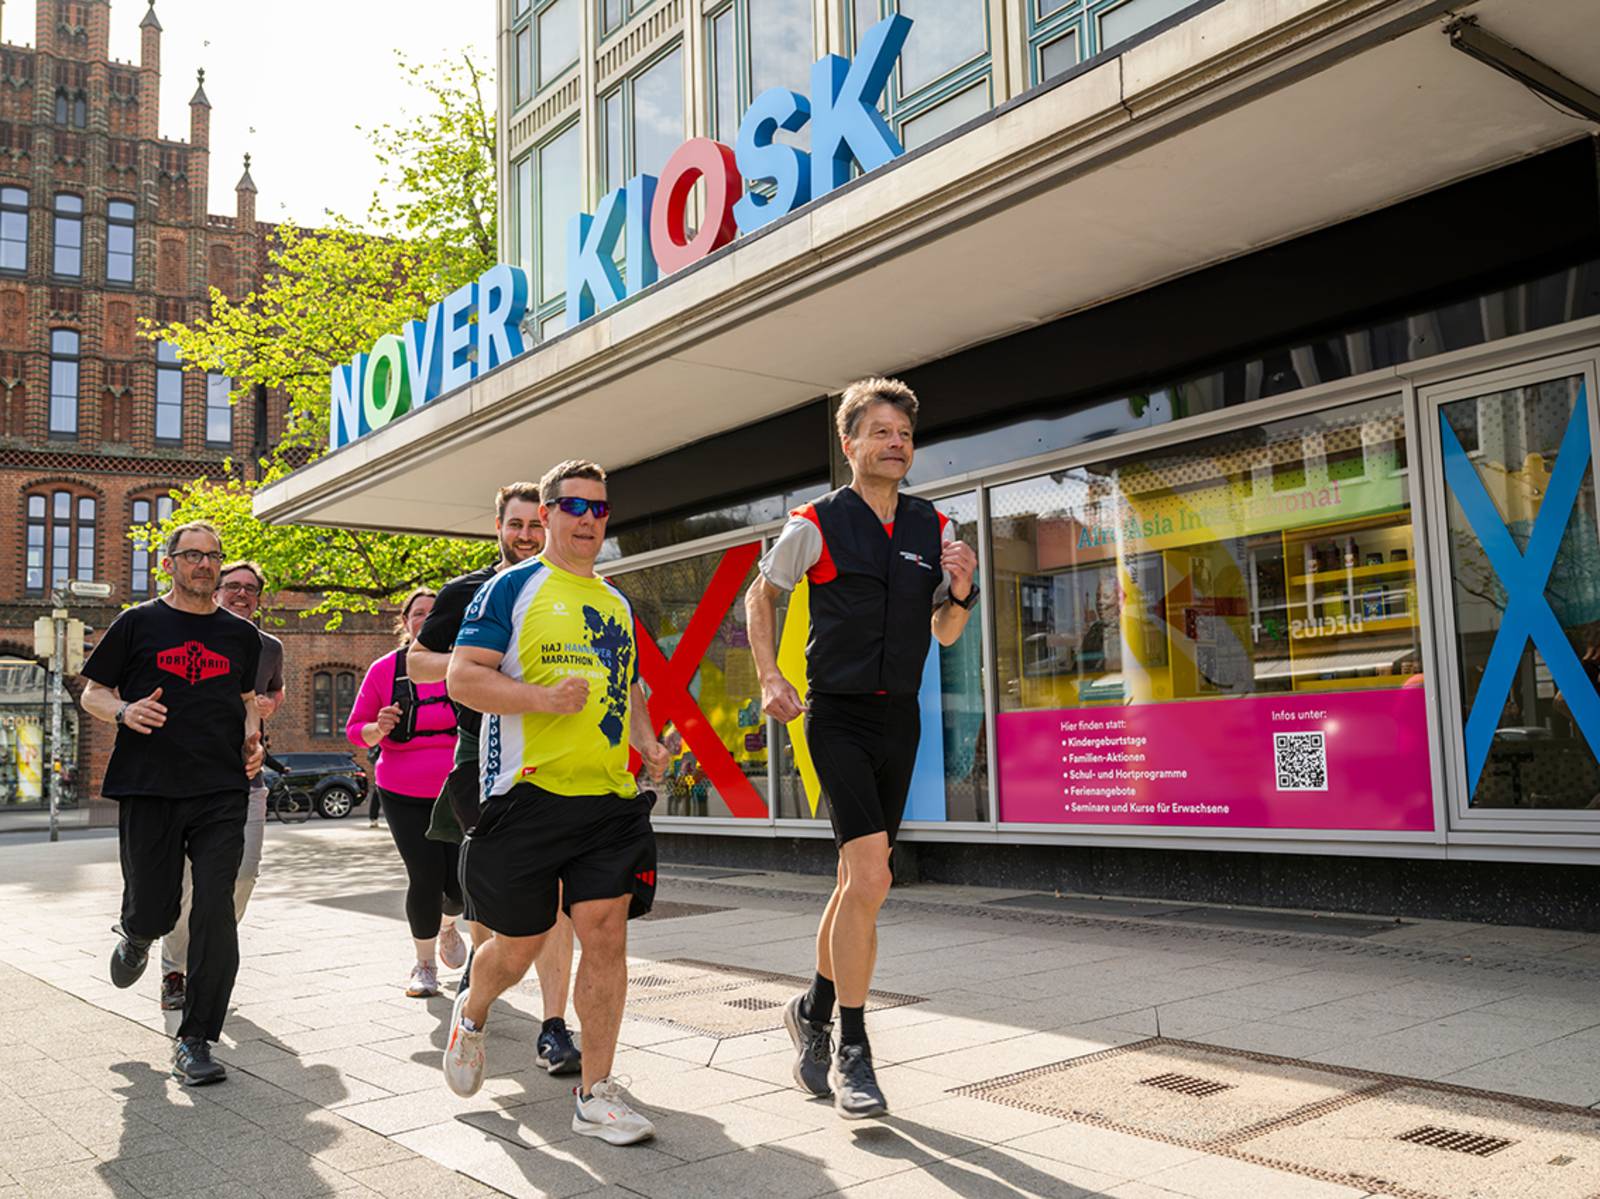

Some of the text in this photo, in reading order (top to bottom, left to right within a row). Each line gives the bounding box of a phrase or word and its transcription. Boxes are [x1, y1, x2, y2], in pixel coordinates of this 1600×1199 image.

[330, 14, 912, 451] NOVER KIOSK
[1180, 480, 1341, 530] Intational
[541, 643, 561, 653] HAJ
[541, 655, 593, 666] MARATHON
[1272, 710, 1328, 721] Infos unter:
[1060, 719, 1127, 731] Hier finden statt:
[1068, 736, 1147, 748] Kindergeburtstage
[1069, 752, 1146, 763] Familien-Aktionen
[1070, 769, 1188, 781] Schul- und Hortprogramme
[1070, 786, 1136, 798] Ferienangebote
[1071, 802, 1230, 814] Seminare und Kurse für Erwachsene
